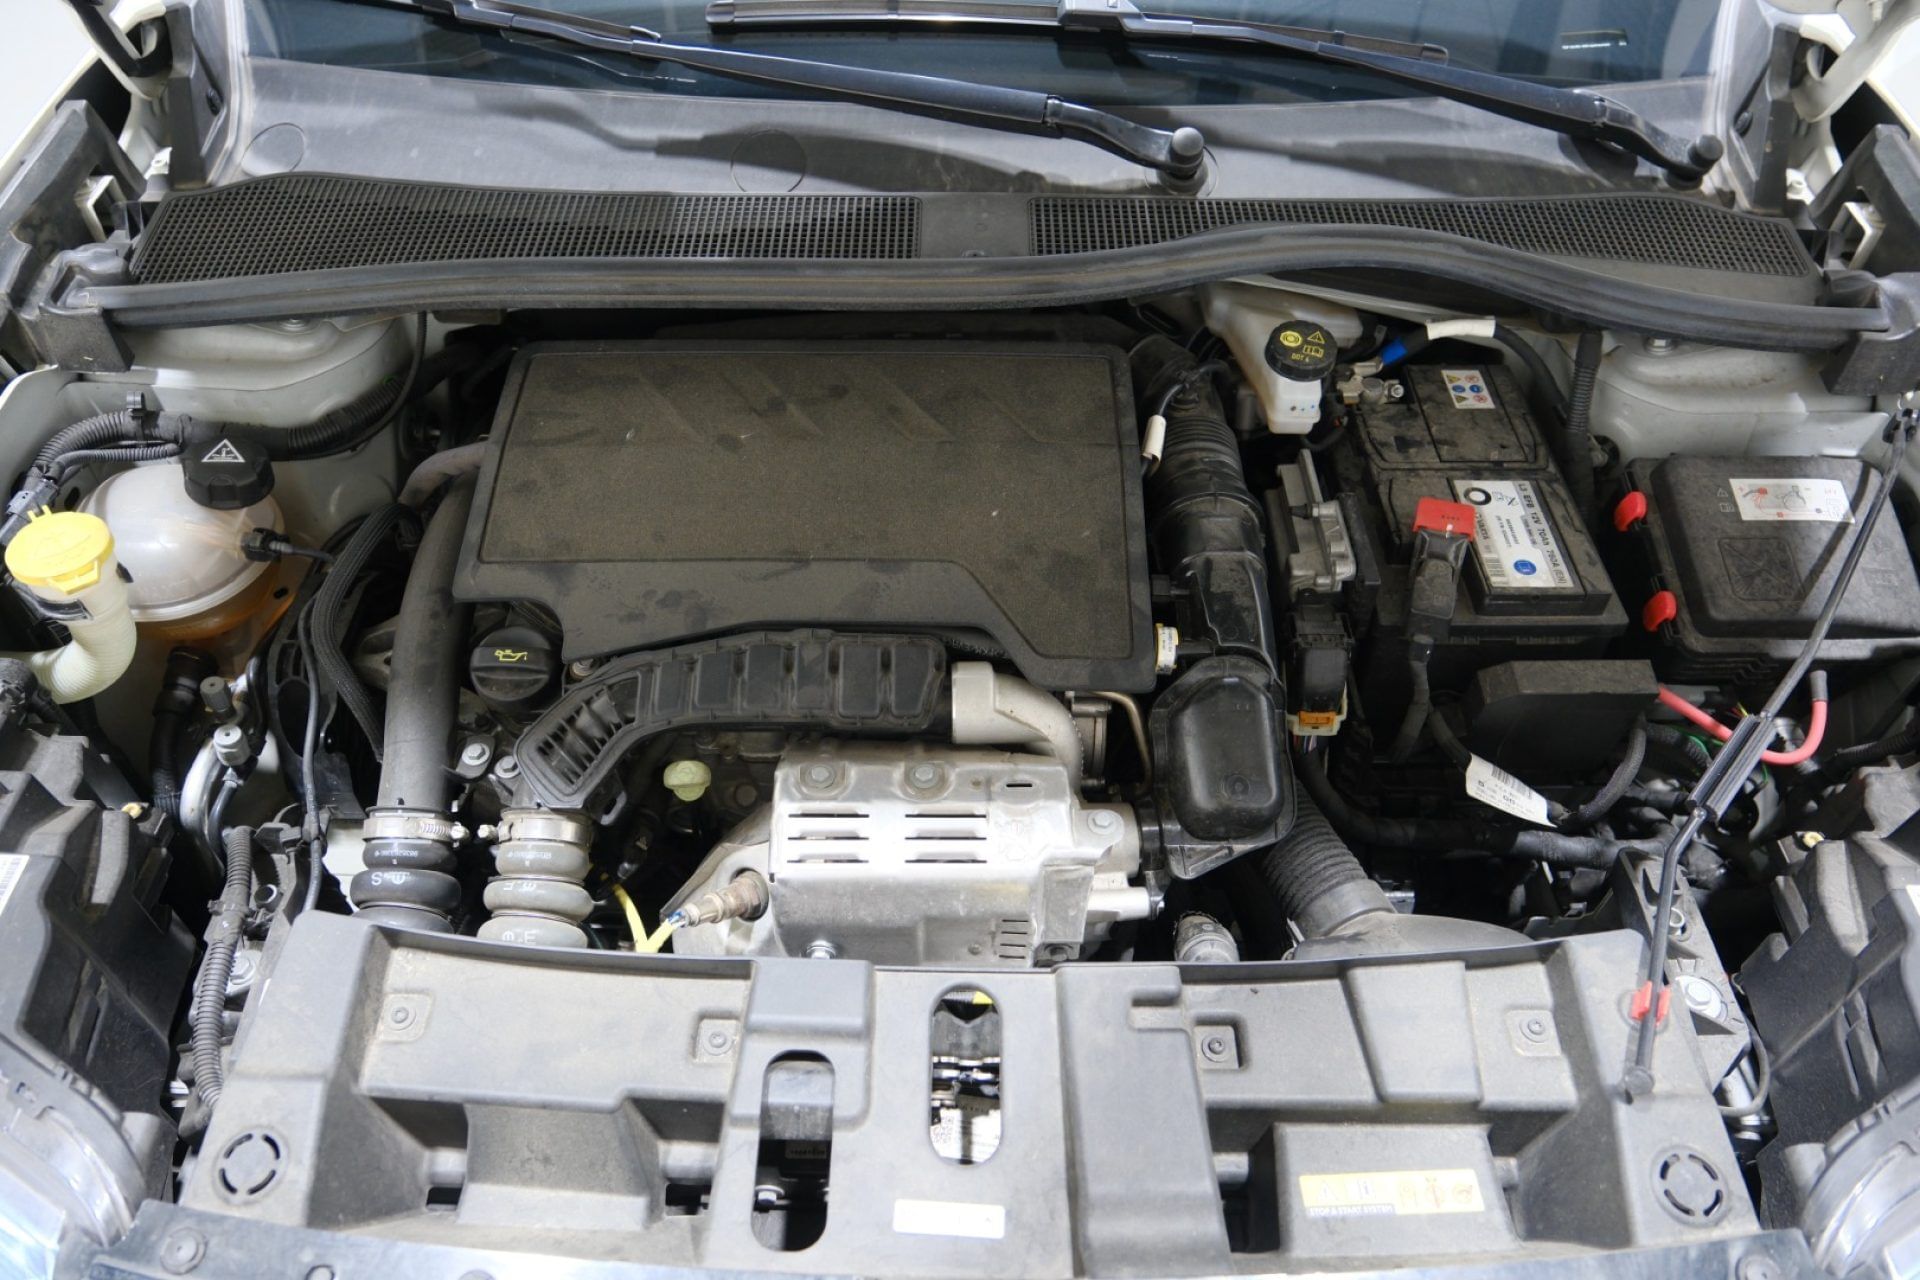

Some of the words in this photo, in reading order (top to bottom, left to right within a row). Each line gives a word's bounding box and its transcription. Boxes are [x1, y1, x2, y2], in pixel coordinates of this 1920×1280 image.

[1291, 353, 1304, 361] DOT
[1523, 494, 1536, 509] EFB
[1530, 511, 1542, 526] 12V
[1537, 528, 1550, 547] 70Ah
